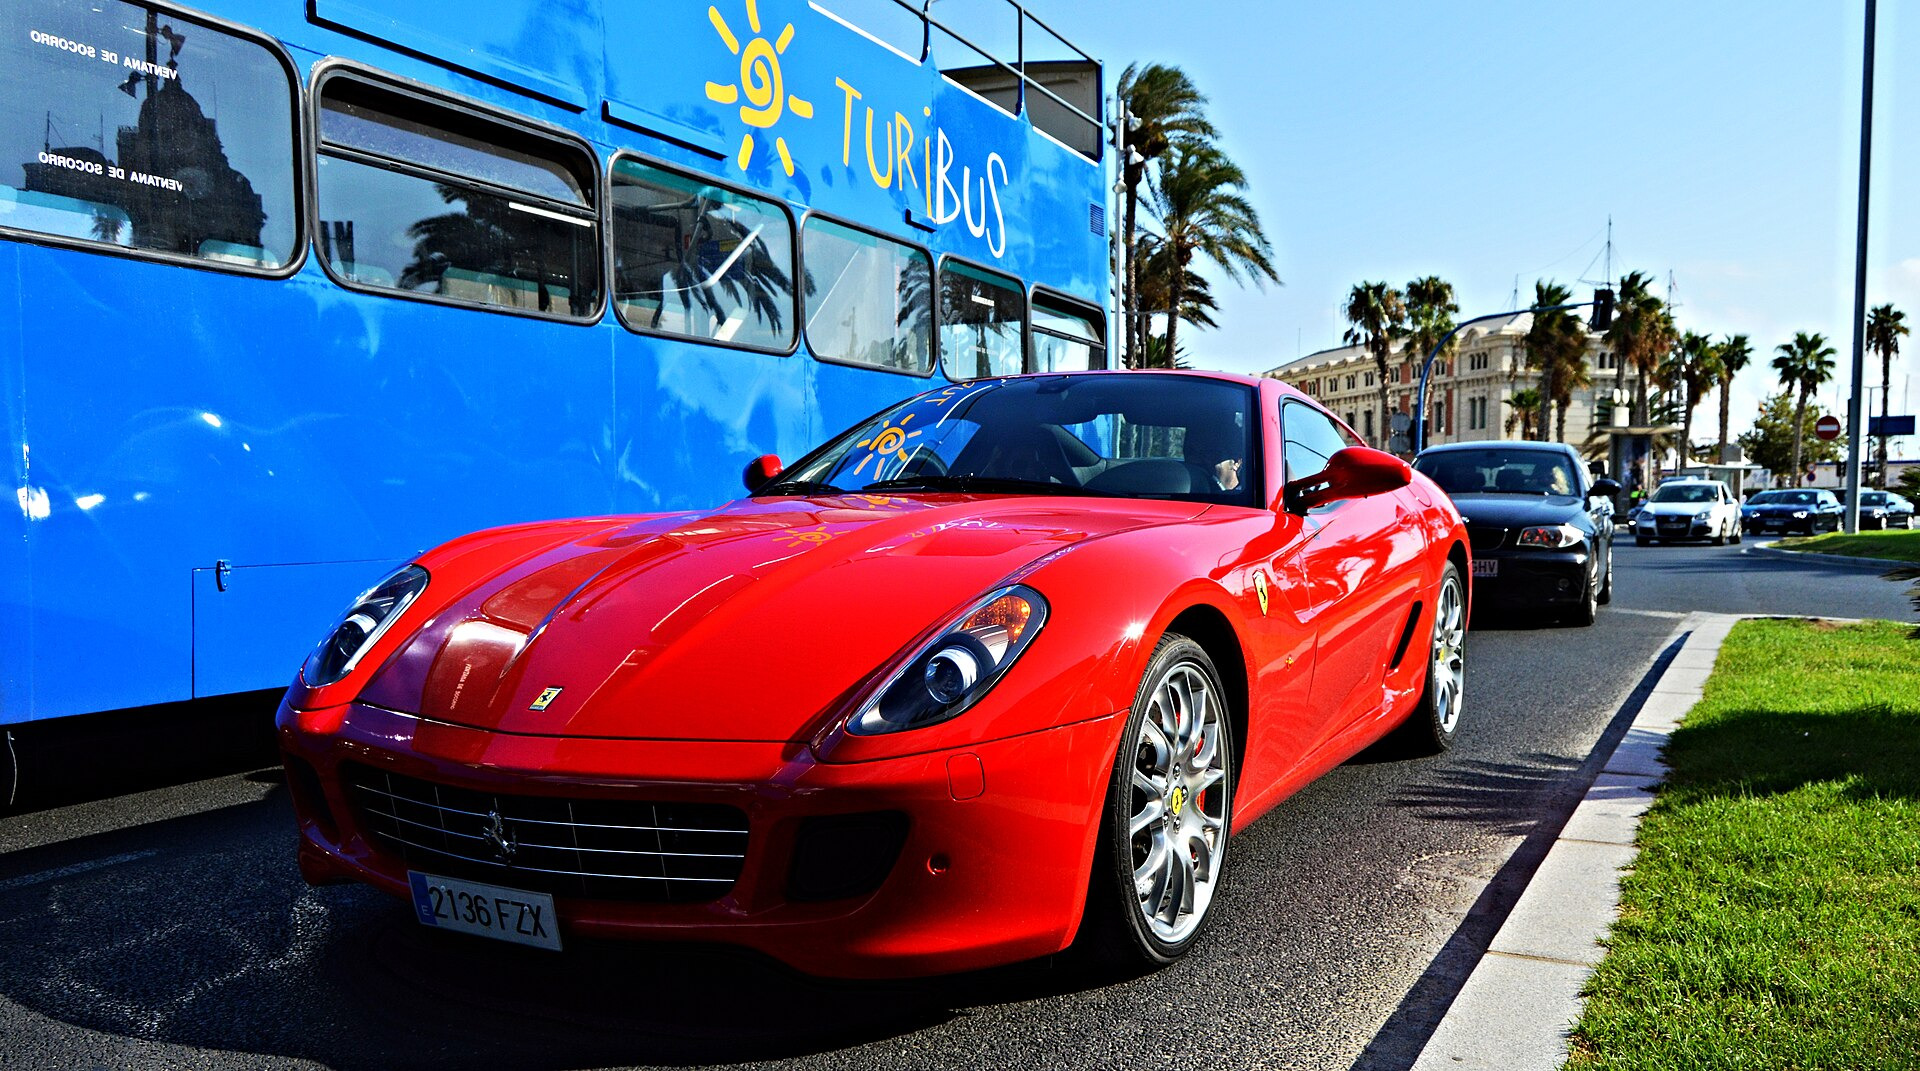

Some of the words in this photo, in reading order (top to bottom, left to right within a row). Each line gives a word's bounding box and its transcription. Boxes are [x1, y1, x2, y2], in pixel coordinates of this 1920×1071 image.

[421, 904, 431, 916] E
[428, 886, 492, 927] 2136
[495, 898, 548, 938] FZX
